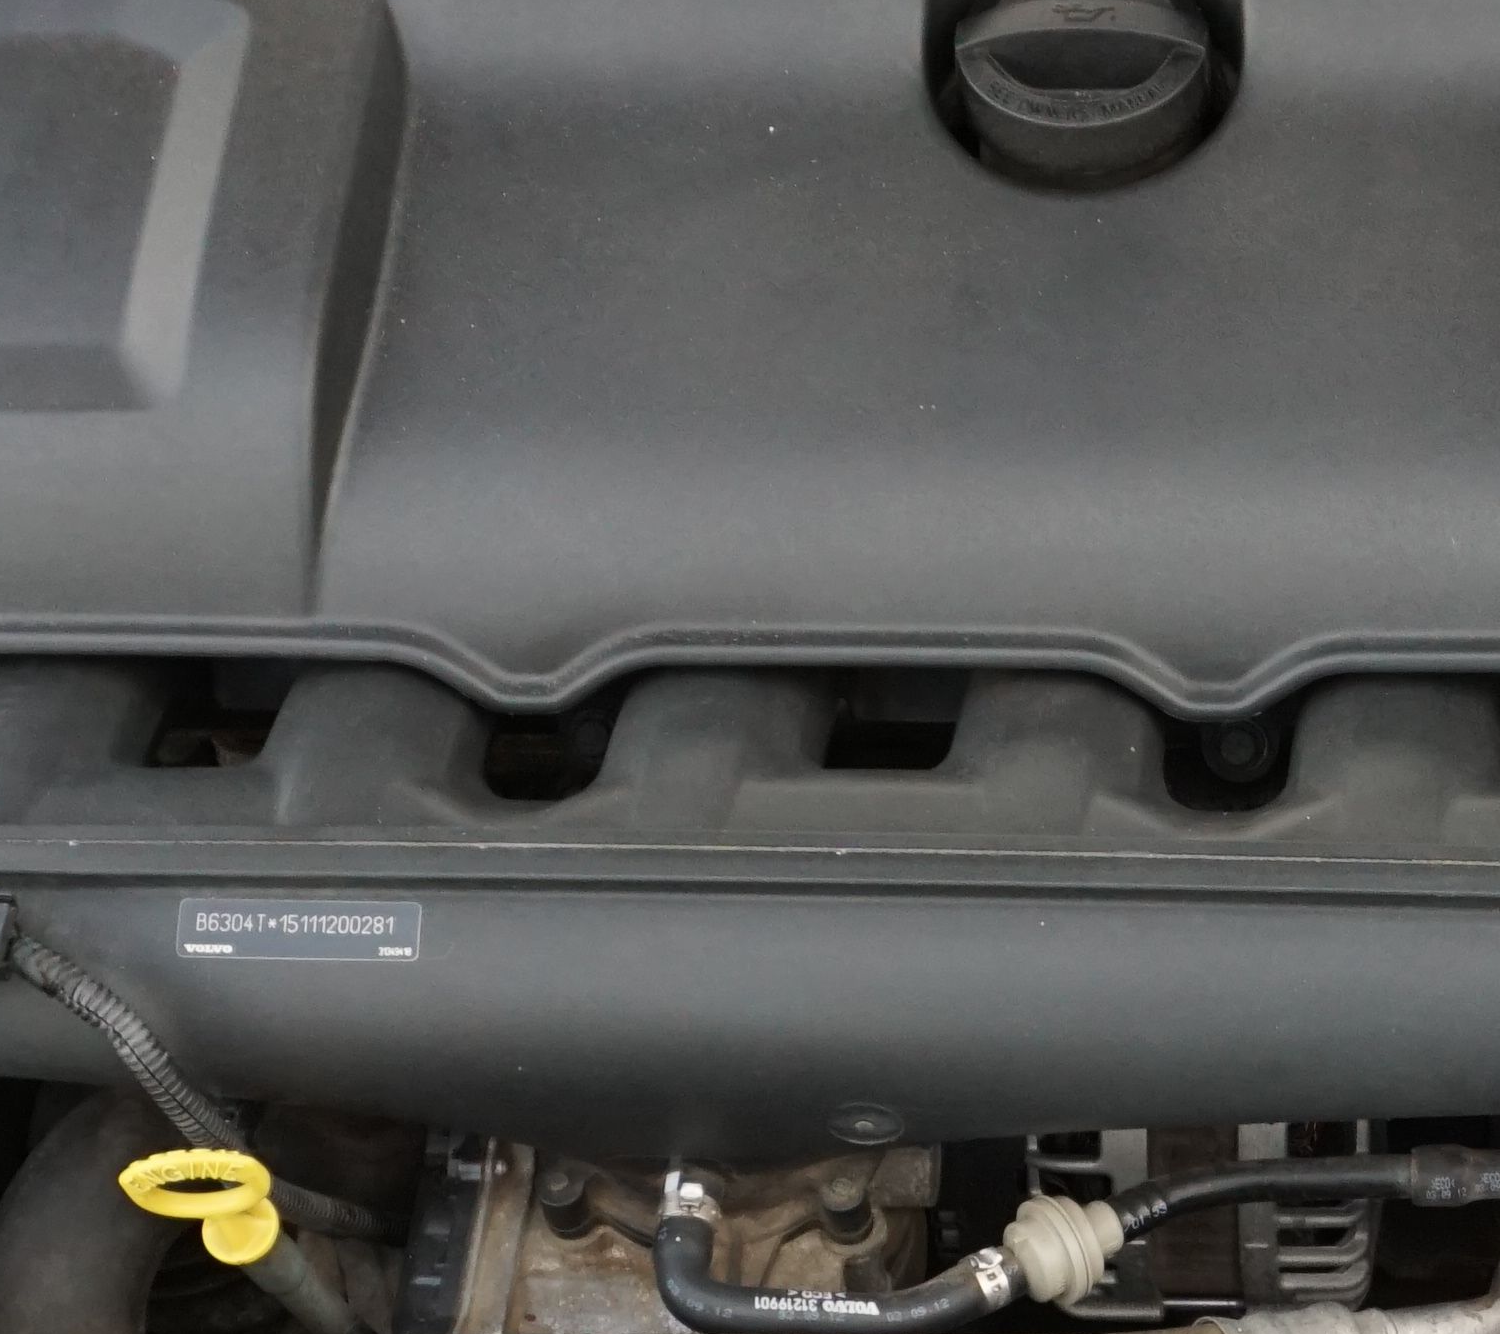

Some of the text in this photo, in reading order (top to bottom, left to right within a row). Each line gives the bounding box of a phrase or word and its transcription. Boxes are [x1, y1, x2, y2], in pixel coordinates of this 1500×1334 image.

[183, 943, 233, 954] VOLVO
[129, 1161, 244, 1193] ENGINE
[754, 1296, 879, 1315] VOLVO 31219901
